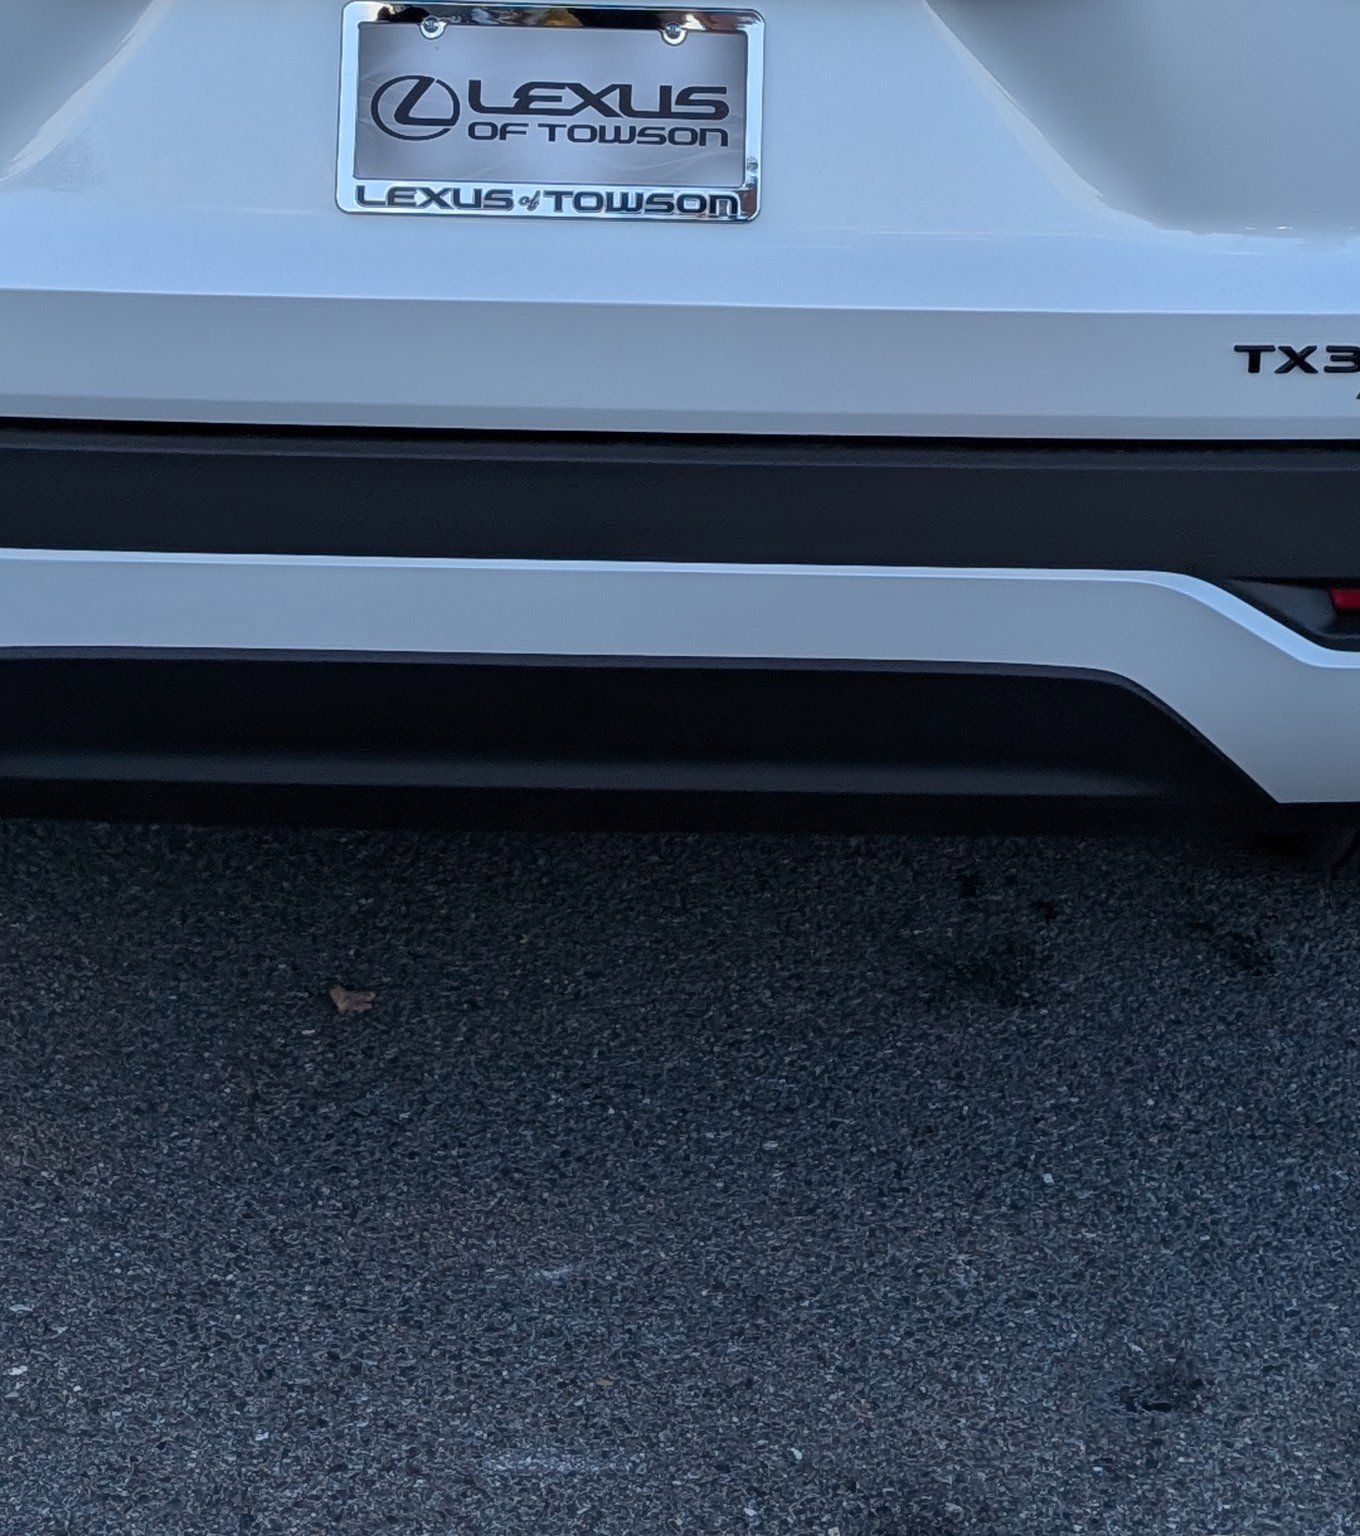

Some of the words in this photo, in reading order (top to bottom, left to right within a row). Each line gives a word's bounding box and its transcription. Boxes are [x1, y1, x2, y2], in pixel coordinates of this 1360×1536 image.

[468, 79, 730, 121] LEXUS
[467, 121, 530, 141] OF
[537, 123, 729, 147] TOWSON
[355, 185, 514, 210] LEXUS
[518, 190, 540, 212] of
[543, 189, 741, 219] TOWSON
